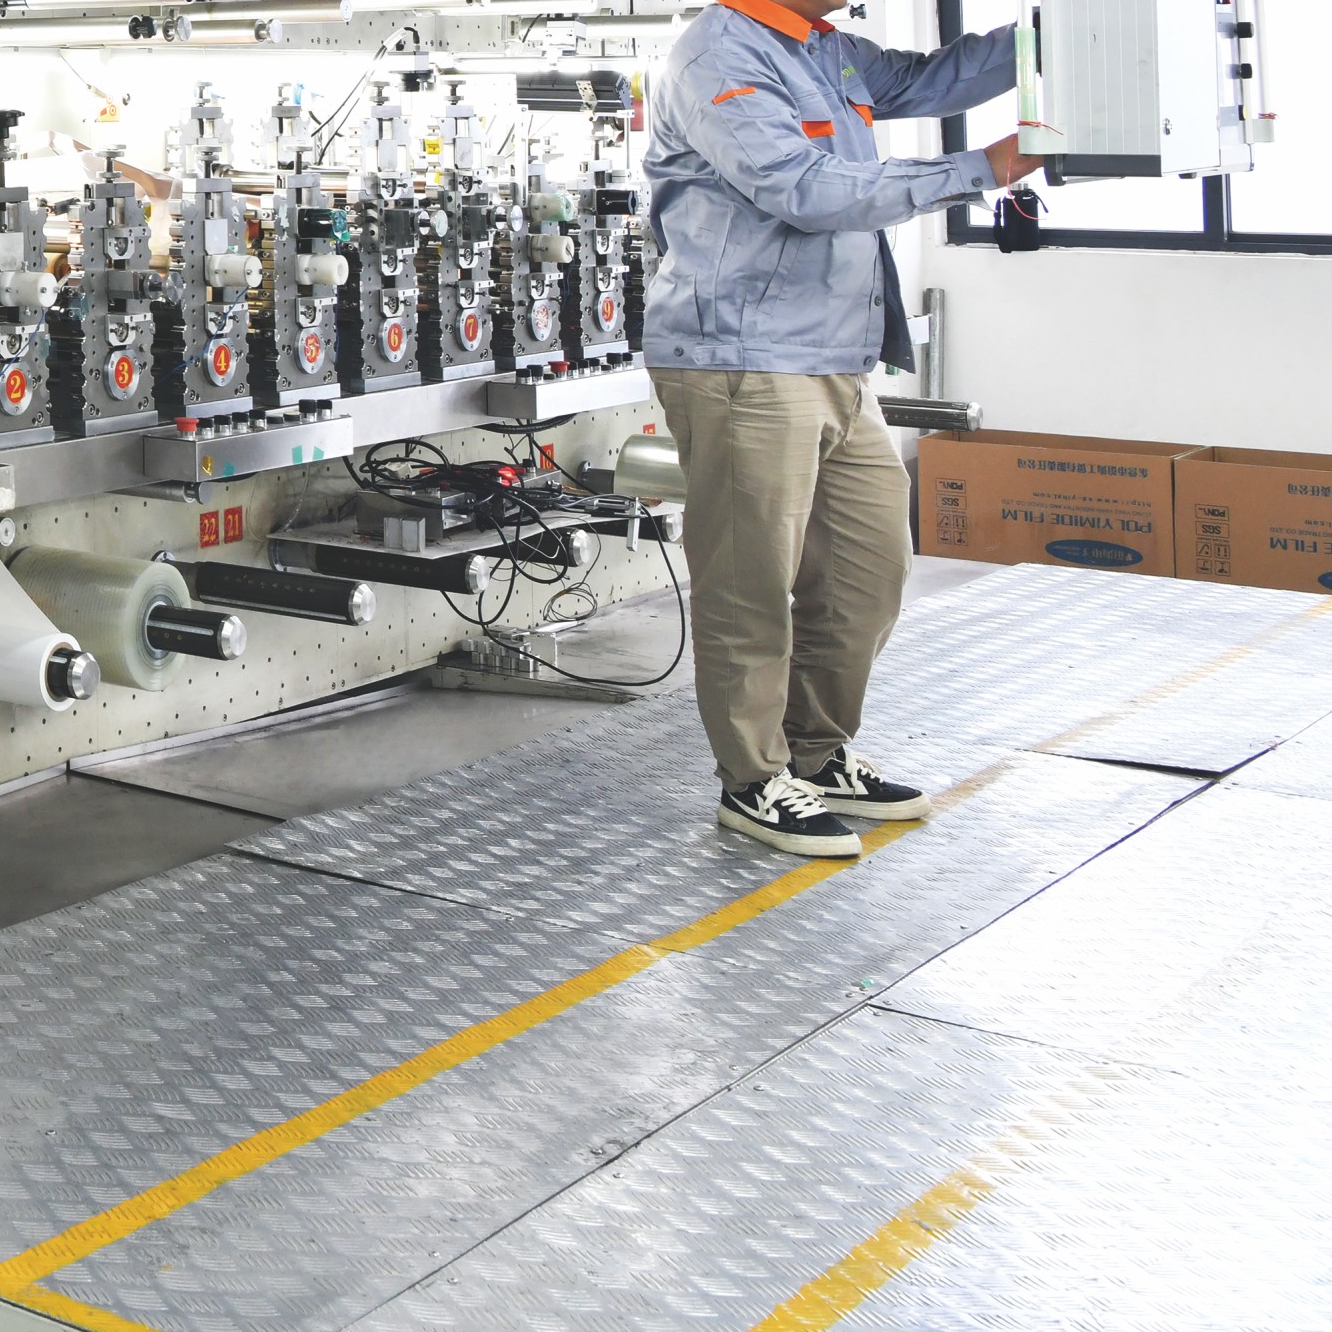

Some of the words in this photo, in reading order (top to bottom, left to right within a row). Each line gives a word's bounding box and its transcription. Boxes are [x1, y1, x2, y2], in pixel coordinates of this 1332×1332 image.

[604, 305, 611, 319] 9
[390, 327, 399, 348] 6
[467, 318, 475, 337] 7
[307, 338, 317, 358] 5
[216, 348, 226, 371] 4
[118, 358, 129, 384] 3
[10, 375, 22, 399] 2
[942, 497, 960, 507] SGS
[227, 514, 240, 537] 21
[1002, 508, 1045, 524] FILM
[203, 518, 216, 542] 22
[1201, 524, 1221, 535] SGS
[1269, 537, 1318, 553] FILM
